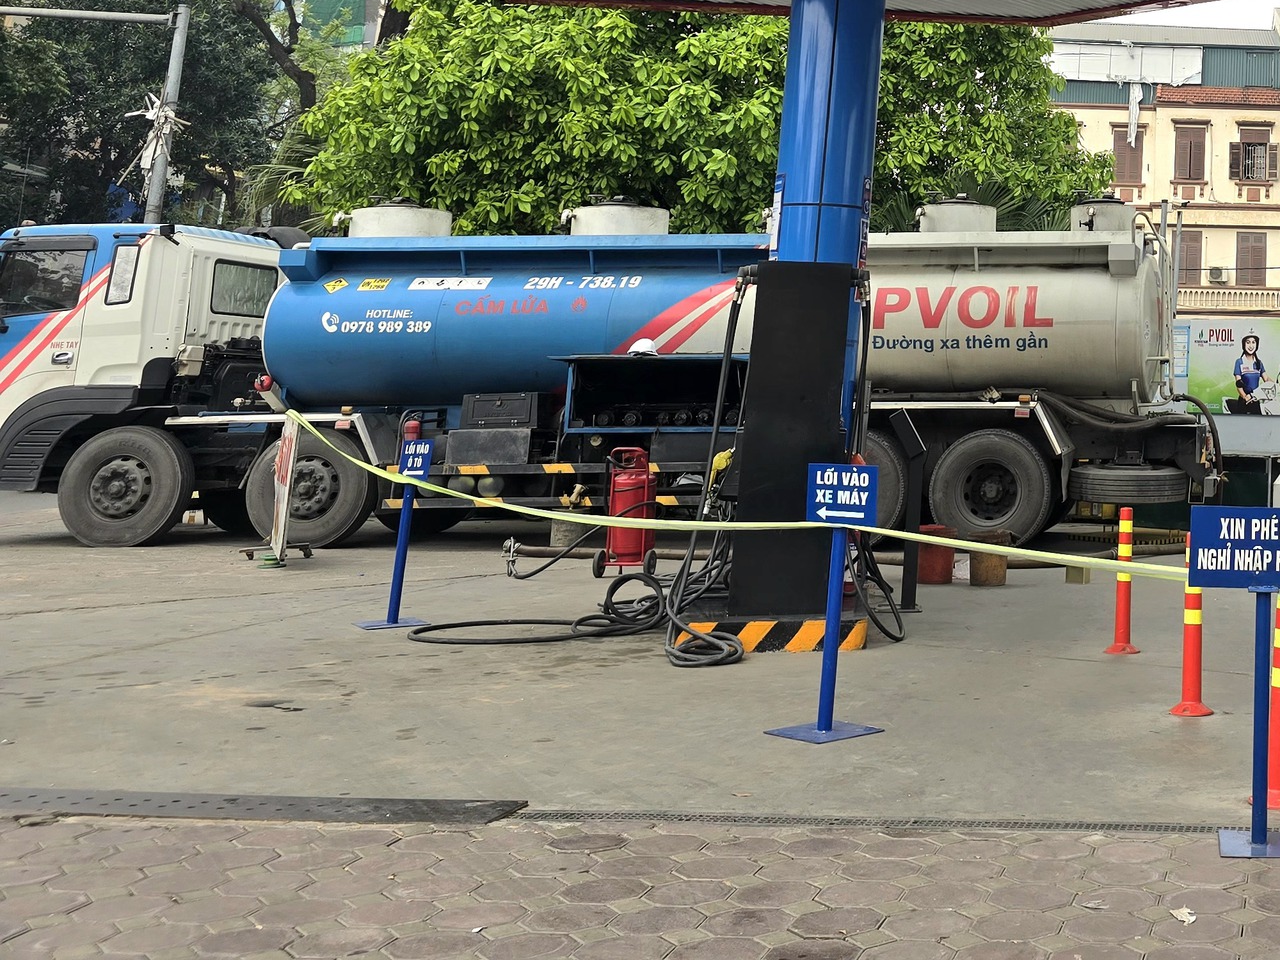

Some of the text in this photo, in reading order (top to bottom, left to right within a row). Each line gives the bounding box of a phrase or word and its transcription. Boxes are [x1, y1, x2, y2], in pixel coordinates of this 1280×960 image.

[523, 276, 564, 290] 29H
[578, 275, 643, 289] 738.19
[365, 309, 413, 319] HOTLINE:
[455, 295, 549, 315] CẤM LỬA
[872, 285, 1054, 330] PVOIL
[341, 321, 432, 333] 0978 989 389
[1208, 328, 1235, 342] PVOIL
[50, 341, 79, 350] NHẸ TAY
[872, 331, 1048, 353] Đường xa thêm gần
[405, 441, 430, 455] LỐI VÀO
[816, 466, 869, 487] LỐI VÀO
[815, 488, 869, 506] XE MÁY
[1219, 517, 1246, 540] XIN
[1197, 542, 1232, 571] NGHỈ
[1234, 545, 1273, 575] NHẬP
